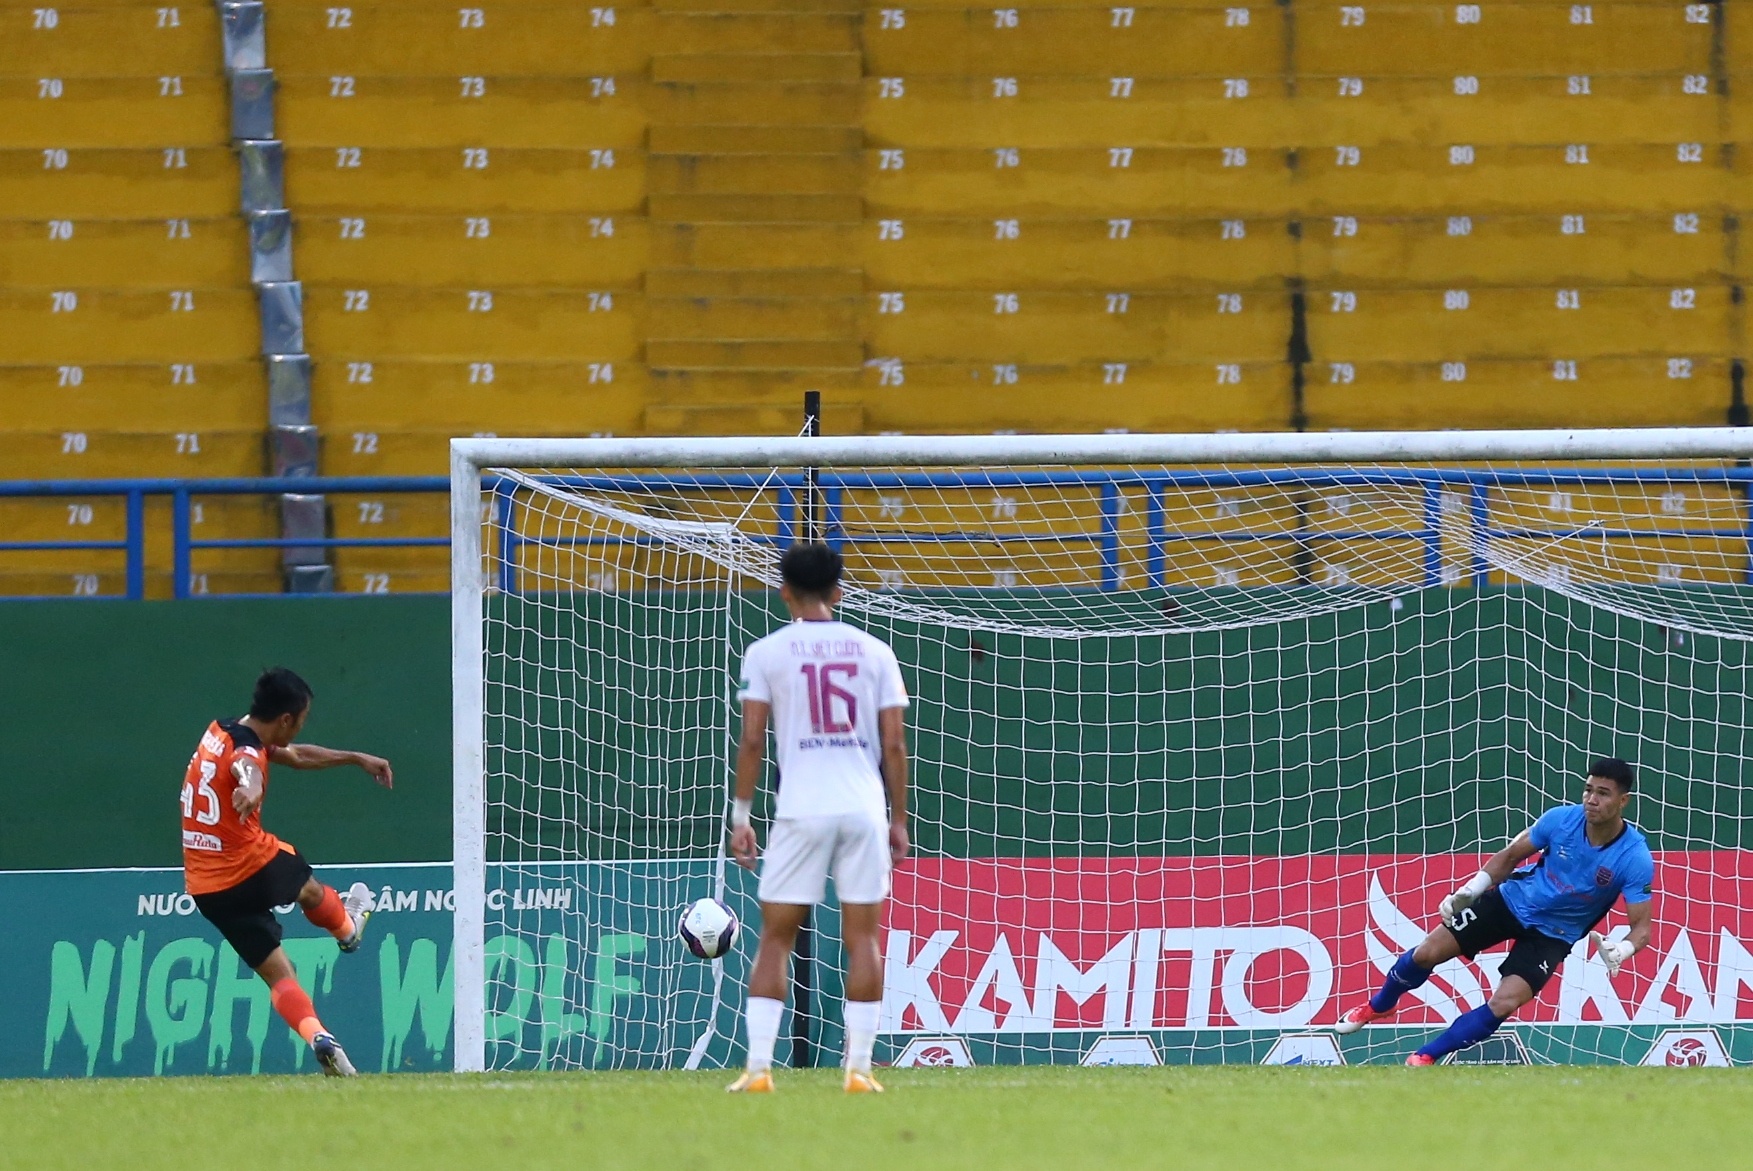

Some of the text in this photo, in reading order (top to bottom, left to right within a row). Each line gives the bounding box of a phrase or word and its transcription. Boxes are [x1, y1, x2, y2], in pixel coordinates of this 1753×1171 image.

[33, 7, 59, 29] 70
[156, 7, 180, 28] 71
[326, 7, 353, 29] 72
[459, 8, 485, 28] 73
[590, 7, 616, 27] 74
[880, 9, 906, 29] 75
[994, 8, 1019, 28] 76
[1111, 7, 1135, 27] 77
[1225, 7, 1250, 27] 78
[1340, 6, 1365, 27] 79
[1455, 4, 1482, 25] 80
[1569, 4, 1594, 25] 81
[1685, 3, 1711, 24] 82
[38, 78, 64, 99] 70
[159, 76, 183, 96] 71
[330, 75, 355, 97] 72
[460, 76, 486, 97] 73
[591, 77, 616, 97] 74
[879, 77, 905, 99] 75
[992, 77, 1018, 98] 76
[1110, 77, 1135, 98] 77
[1223, 78, 1250, 99] 78
[1338, 77, 1364, 97] 79
[1453, 75, 1480, 96] 80
[1567, 75, 1591, 95] 81
[1682, 74, 1709, 95] 82
[43, 148, 69, 169] 70
[164, 148, 187, 168] 71
[336, 147, 361, 168] 72
[463, 147, 489, 170] 73
[590, 149, 615, 169] 74
[879, 149, 905, 170] 75
[995, 147, 1020, 168] 76
[1108, 146, 1134, 168] 77
[1222, 147, 1248, 167] 78
[1336, 145, 1361, 166] 79
[1449, 145, 1475, 166] 80
[1565, 144, 1590, 165] 81
[1677, 142, 1703, 163] 82
[48, 219, 74, 241] 70
[167, 219, 191, 239] 71
[339, 217, 366, 239] 72
[465, 217, 491, 239] 73
[589, 217, 615, 237] 74
[878, 219, 904, 241] 75
[994, 218, 1020, 240] 76
[1108, 218, 1132, 239] 77
[1221, 220, 1246, 240] 78
[1333, 215, 1359, 237] 79
[1446, 216, 1473, 237] 80
[1560, 214, 1586, 235] 81
[1673, 212, 1700, 234] 82
[51, 291, 78, 313] 70
[170, 290, 195, 312] 71
[344, 289, 370, 312] 72
[467, 290, 493, 312] 73
[588, 292, 613, 312] 74
[879, 291, 905, 314] 75
[994, 293, 1020, 314] 76
[1106, 293, 1130, 314] 77
[1217, 293, 1243, 314] 78
[1330, 291, 1357, 313] 79
[1443, 289, 1470, 311] 80
[1555, 289, 1581, 310] 81
[1669, 287, 1697, 310] 82
[57, 365, 84, 387] 70
[170, 363, 196, 385] 71
[347, 362, 373, 384] 72
[469, 362, 495, 384] 73
[588, 362, 614, 384] 74
[879, 363, 905, 387] 75
[993, 364, 1019, 385] 76
[1103, 363, 1128, 385] 77
[1215, 363, 1241, 385] 78
[1330, 362, 1355, 384] 79
[1441, 361, 1467, 382] 80
[1552, 359, 1578, 381] 81
[1666, 357, 1693, 379] 82
[60, 432, 88, 454] 70
[174, 432, 200, 454] 71
[352, 432, 379, 453] 72
[67, 504, 94, 525] 70
[193, 503, 204, 523] 1
[358, 503, 385, 523] 72
[73, 574, 99, 595] 70
[363, 573, 390, 595] 72
[801, 663, 858, 734] 16
[180, 760, 221, 826] 43
[513, 888, 572, 910] LINH
[879, 926, 1333, 1028] KAMITO
[43, 930, 646, 1076] NIGHT WOLF
